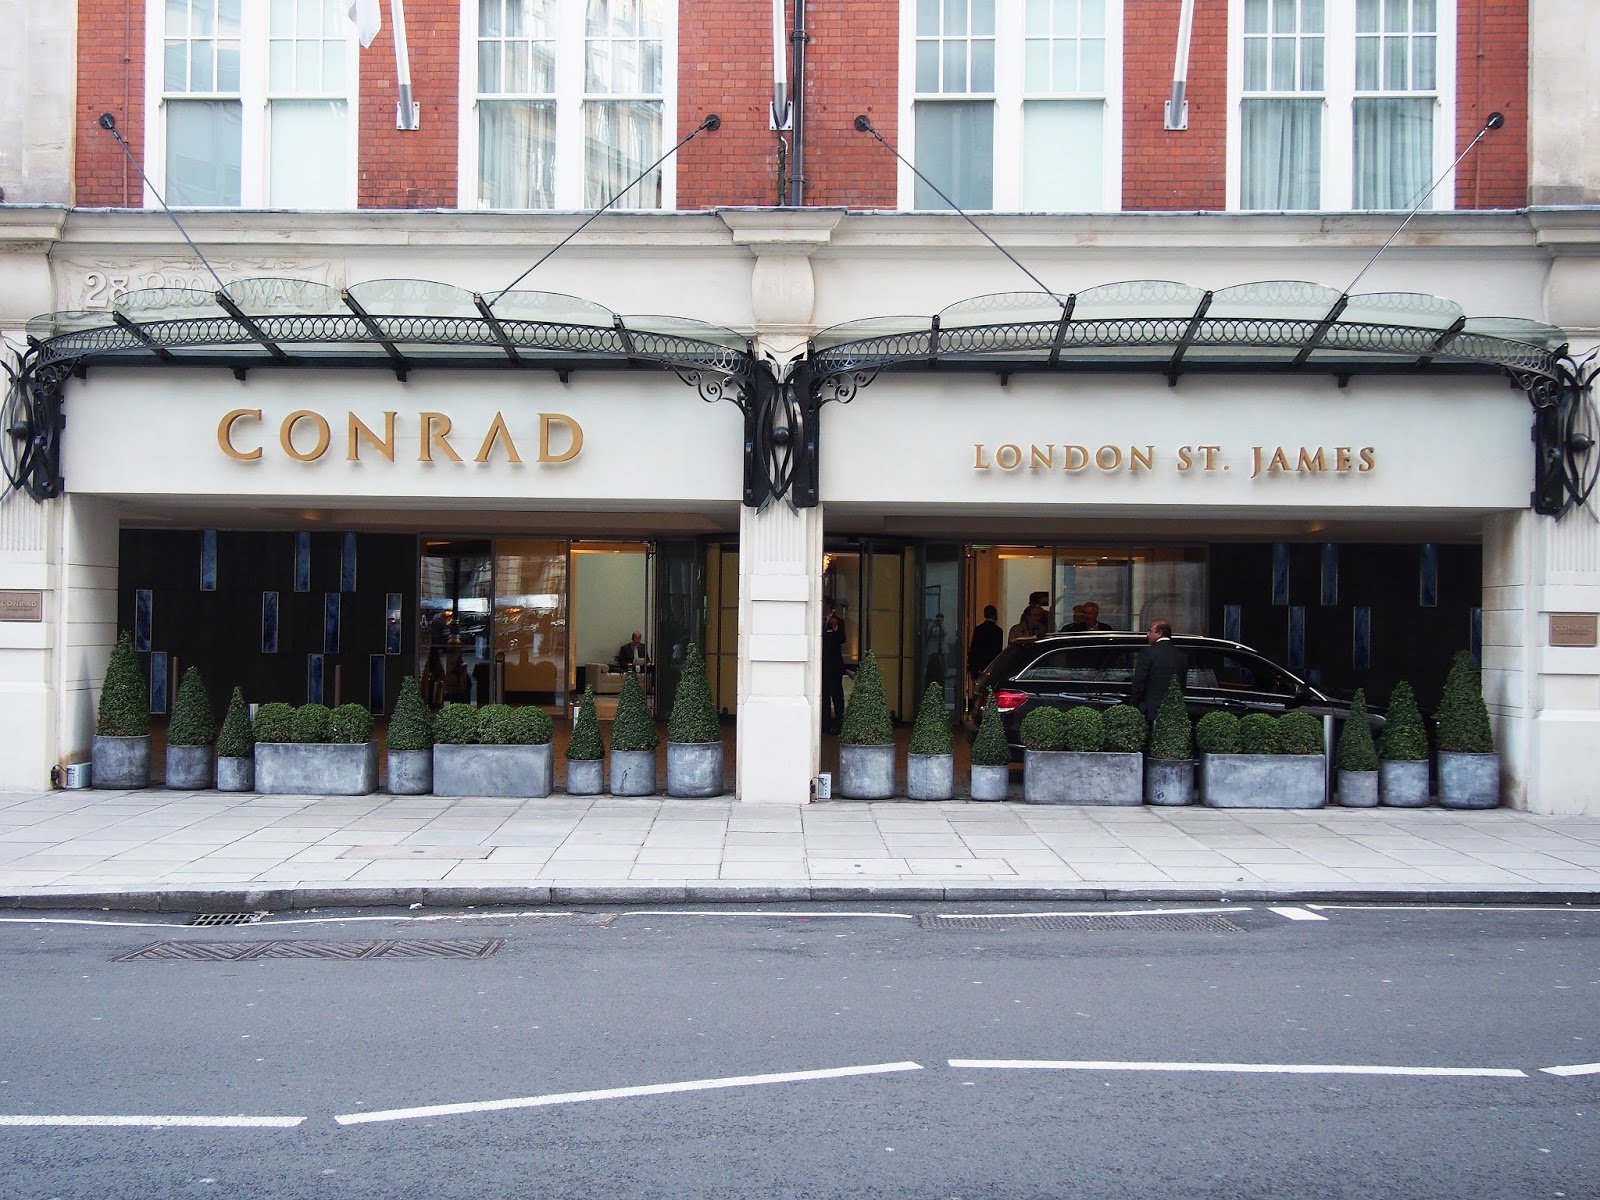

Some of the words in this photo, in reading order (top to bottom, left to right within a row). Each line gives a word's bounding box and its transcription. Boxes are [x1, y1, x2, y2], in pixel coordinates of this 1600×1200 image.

[86, 271, 130, 308] 28
[217, 408, 584, 463] CONRAD
[973, 444, 1155, 471] LONDON
[1177, 445, 1230, 472] ST.
[1250, 446, 1375, 479] JAMES
